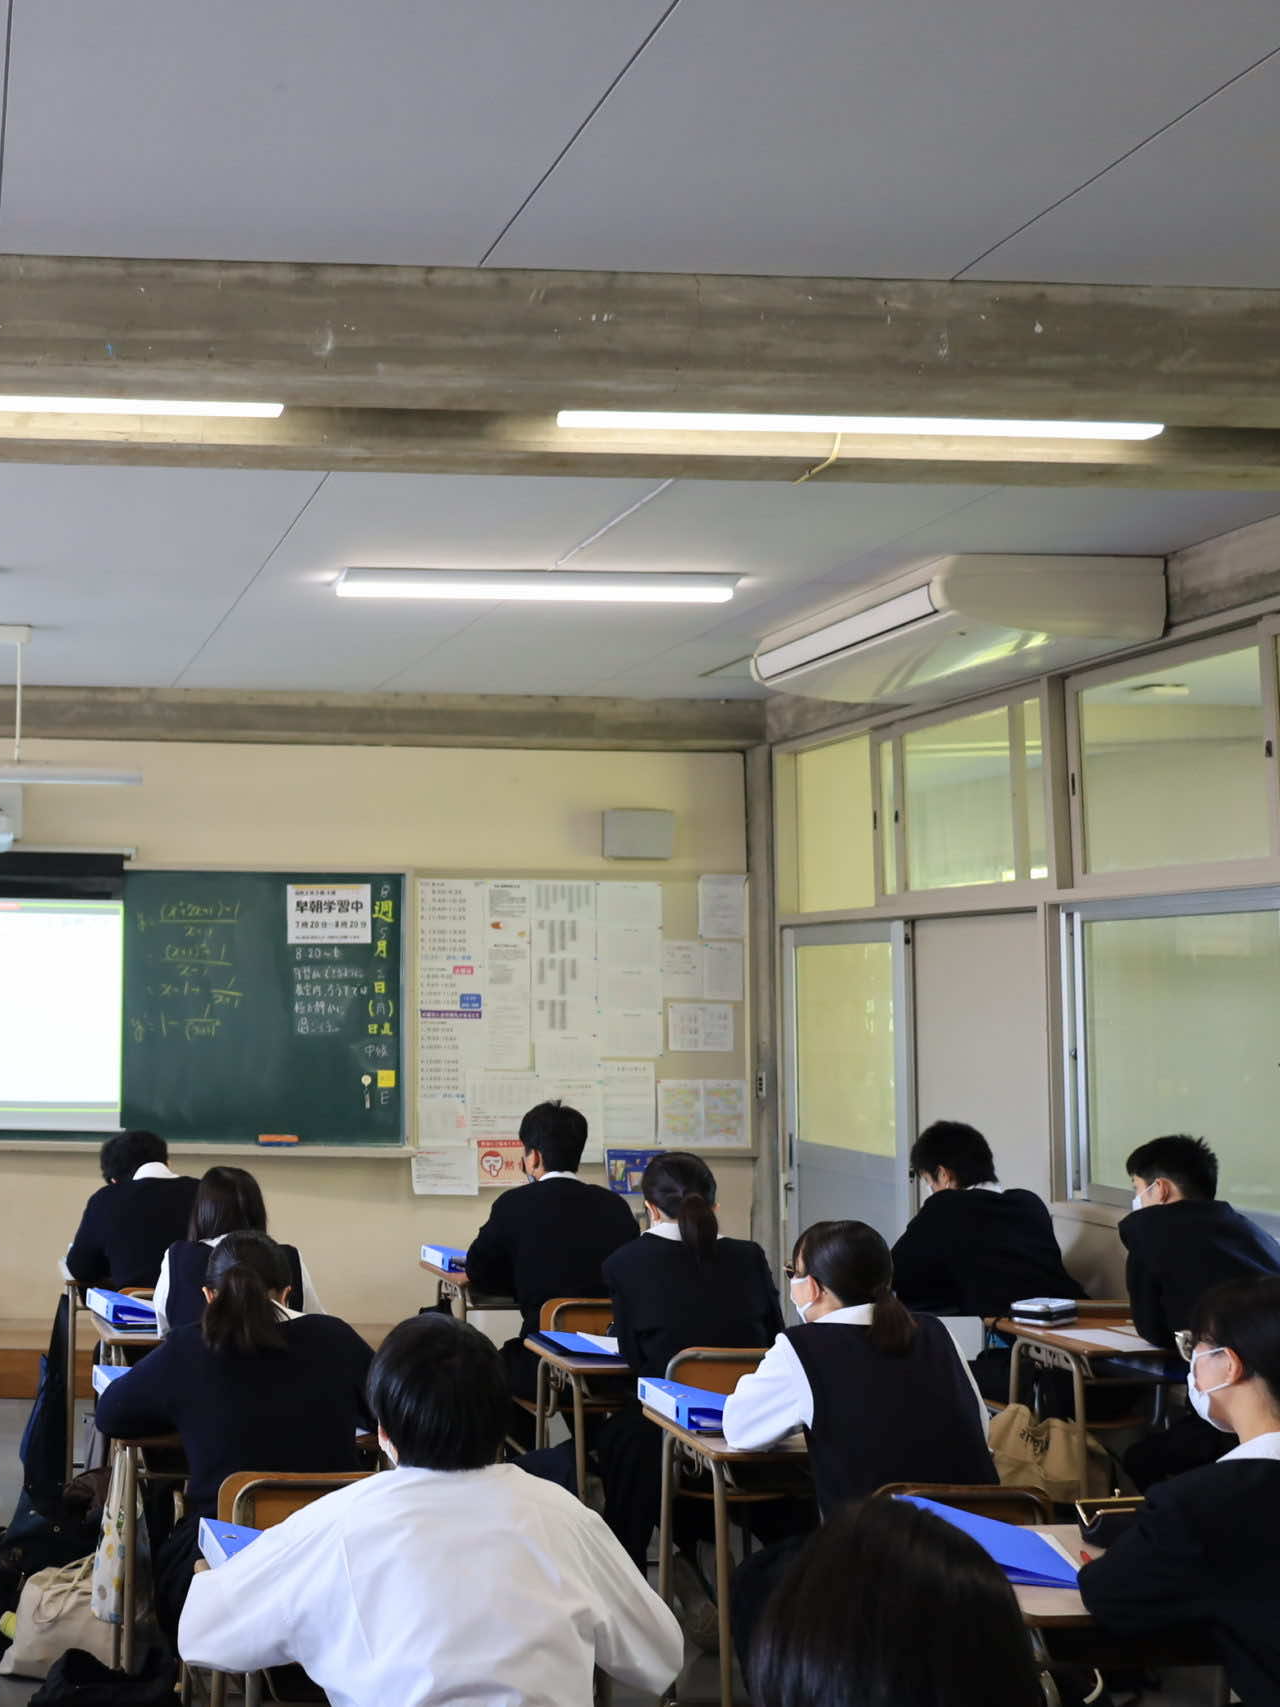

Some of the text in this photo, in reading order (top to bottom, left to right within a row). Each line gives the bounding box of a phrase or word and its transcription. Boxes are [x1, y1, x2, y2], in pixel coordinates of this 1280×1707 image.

[295, 899, 364, 914] 早朝学習中
